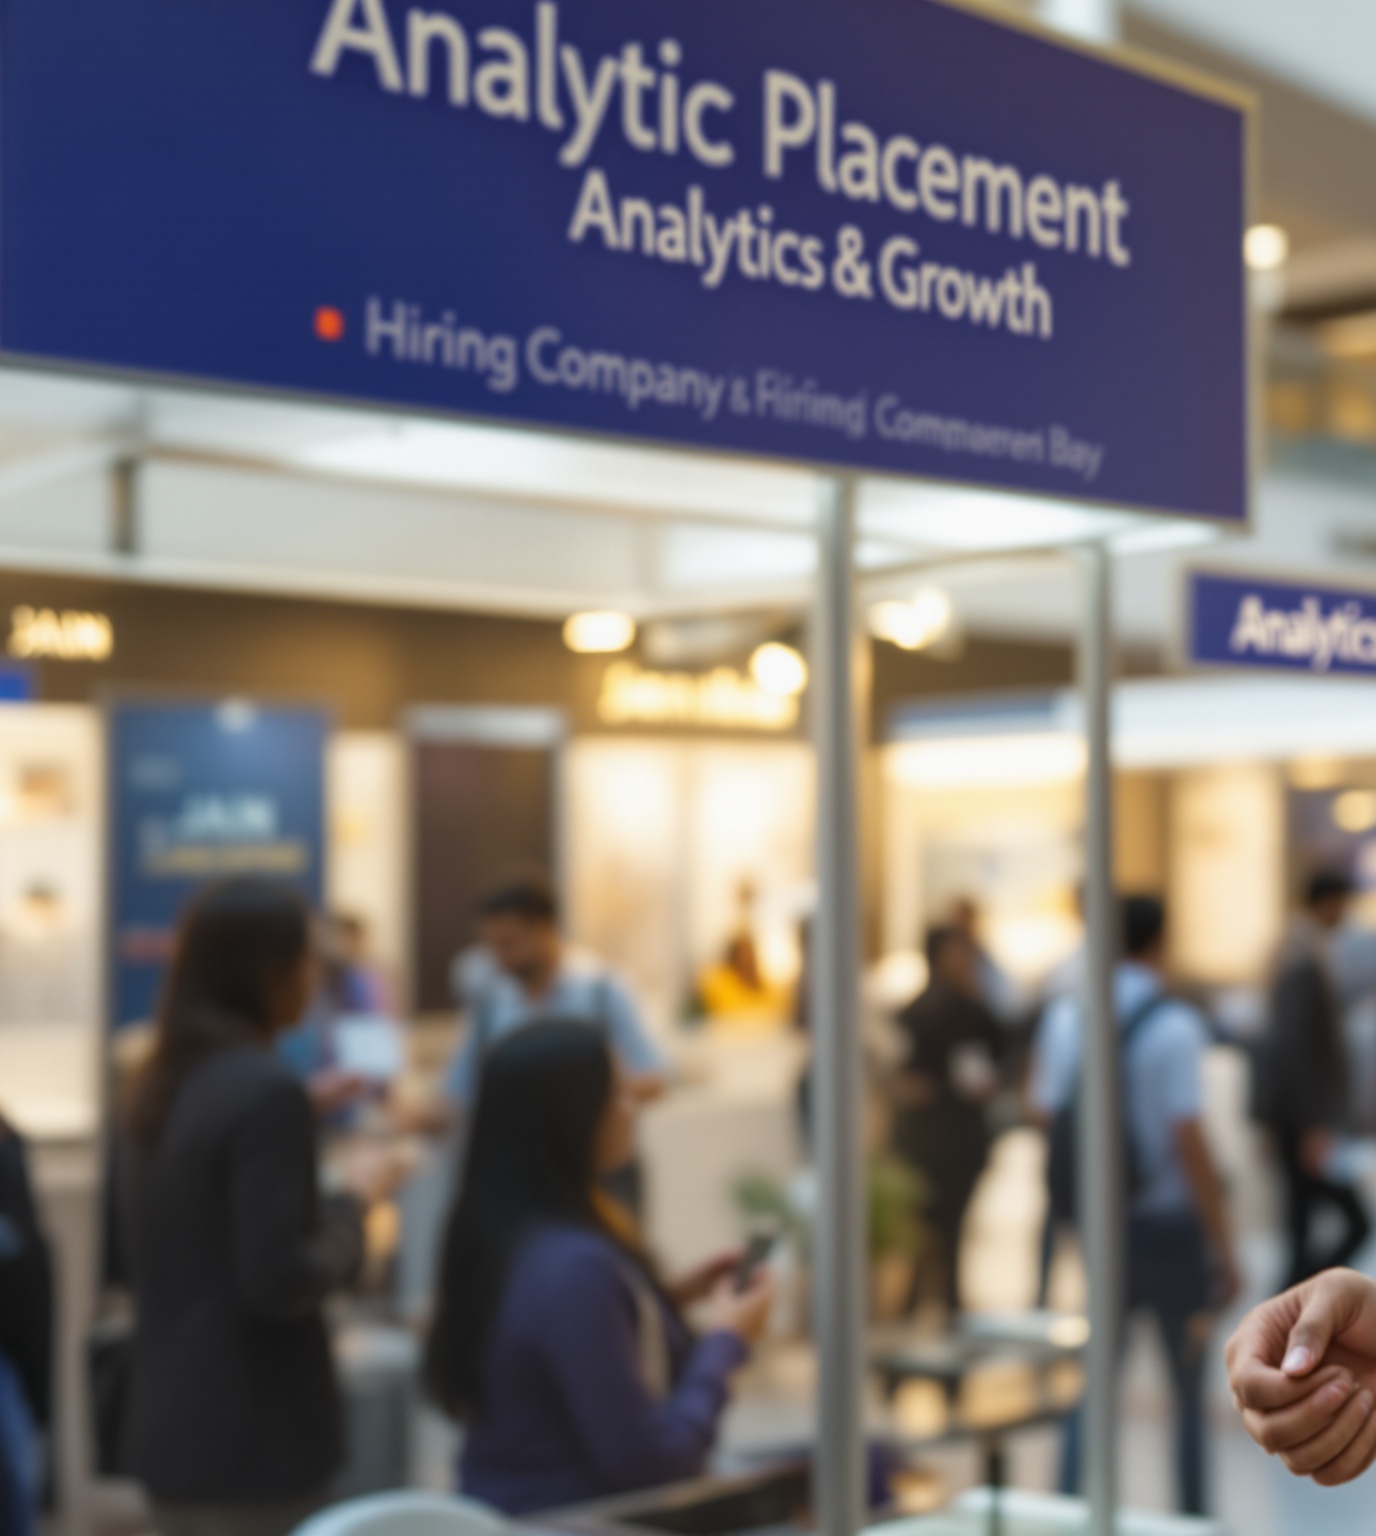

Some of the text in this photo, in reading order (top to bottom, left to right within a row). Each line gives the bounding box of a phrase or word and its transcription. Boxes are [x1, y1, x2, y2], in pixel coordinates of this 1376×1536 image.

[310, 0, 1130, 266] Analytic Placement
[569, 169, 1052, 338] Analytics & Growth
[365, 296, 518, 392] Hiring
[525, 326, 726, 421] Company
